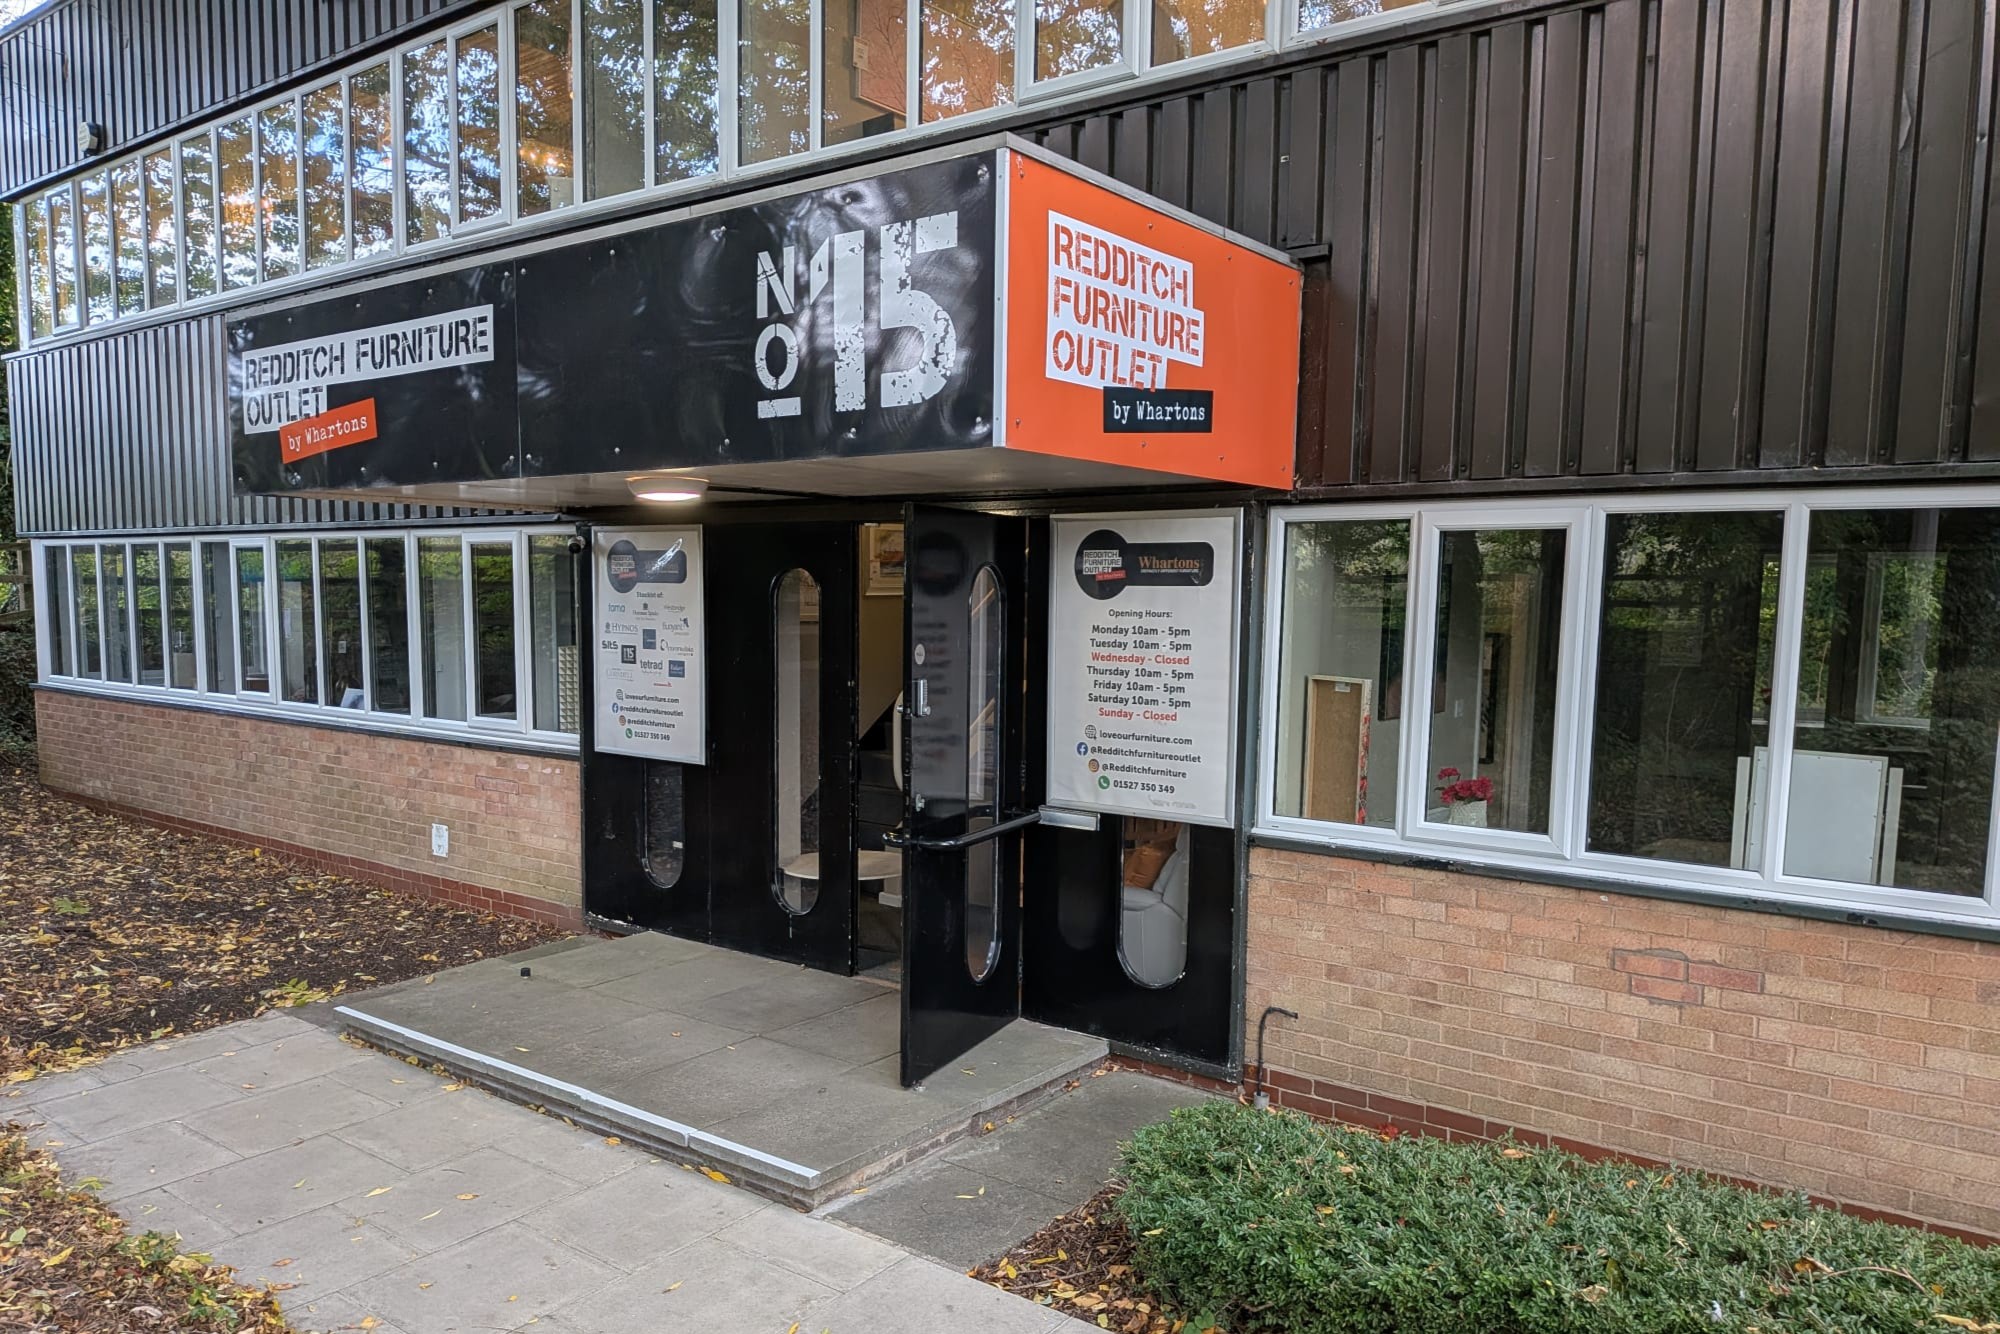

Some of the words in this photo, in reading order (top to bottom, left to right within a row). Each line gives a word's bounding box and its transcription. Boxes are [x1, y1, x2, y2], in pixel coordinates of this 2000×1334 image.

[1053, 222, 1189, 307] REDDITCH
[810, 210, 958, 412] 15
[1053, 275, 1200, 356] FURNITURE
[245, 341, 345, 389] REDDITCH
[355, 315, 489, 373] FURNITURE
[1052, 329, 1163, 392] OUTLET
[247, 385, 324, 427] OUTLET
[1113, 400, 1131, 424] by
[1136, 400, 1206, 422] Whartons
[288, 435, 301, 452] by
[304, 415, 368, 446] Whartons
[1084, 551, 1118, 559] REDDITCH
[1138, 556, 1200, 569] Whartons
[1108, 608, 1143, 619] Opening
[1145, 609, 1173, 618] Hours:
[1092, 624, 1130, 637] Monday
[1132, 625, 1158, 636] 10am
[1168, 627, 1191, 638] 5pm
[1090, 638, 1128, 650] Tuesday
[1132, 640, 1160, 650] 10am
[1169, 641, 1192, 653] 5pm
[640, 659, 663, 670] tetrad
[1091, 652, 1145, 665] Wednesday
[1154, 654, 1190, 665] Closed
[1086, 665, 1130, 679] Thursday
[1134, 668, 1162, 678] 10am
[1171, 669, 1194, 681] 5pm
[1093, 679, 1122, 692] Friday
[1126, 681, 1154, 692] 10am
[1163, 683, 1186, 695] 5pm
[1088, 692, 1129, 706] Saturday
[1131, 695, 1159, 706] 10am
[1168, 697, 1191, 709] 5pm
[1098, 707, 1134, 720] Sunday
[1142, 710, 1178, 721] Closed
[1099, 729, 1193, 745] loveourfurniture.com
[1090, 745, 1202, 763] @Redditchfurnitureoutlet
[1101, 763, 1187, 778] @Redditchfurniture
[1113, 779, 1139, 790] 01527
[1140, 782, 1157, 792] 350
[1158, 784, 1175, 794] 349
